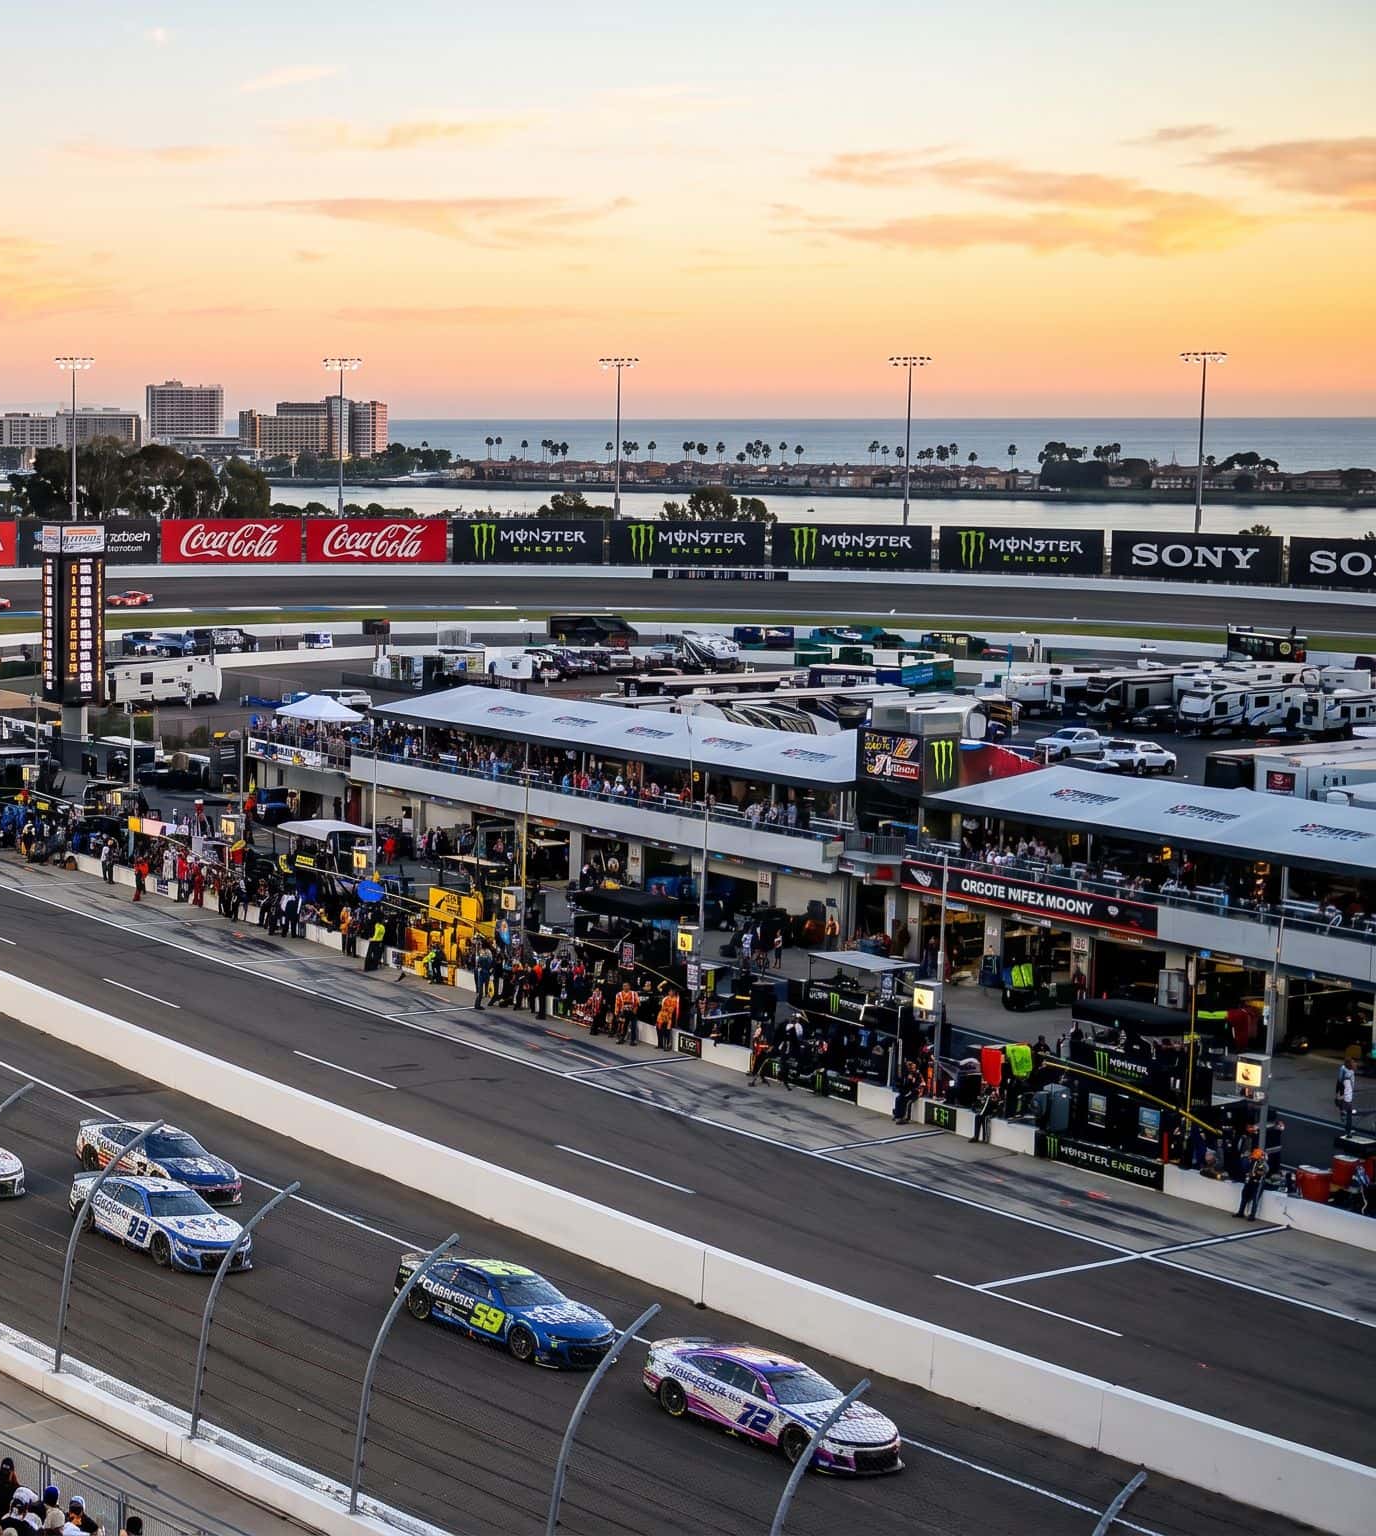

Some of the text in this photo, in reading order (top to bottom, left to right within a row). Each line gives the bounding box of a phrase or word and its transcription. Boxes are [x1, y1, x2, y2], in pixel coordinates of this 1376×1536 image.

[180, 523, 284, 558] Coca-Cola
[323, 523, 428, 558] Coca-Cola
[500, 528, 586, 544] MONSTER
[658, 530, 746, 546] MONSTER
[821, 532, 912, 549] MONSTER
[989, 536, 1083, 554] MONSTER
[1131, 543, 1259, 569] SONY
[1309, 550, 1376, 576] SO
[1060, 1145, 1110, 1167] MONSTER
[469, 1302, 505, 1334] 59
[736, 1402, 776, 1434] 72
